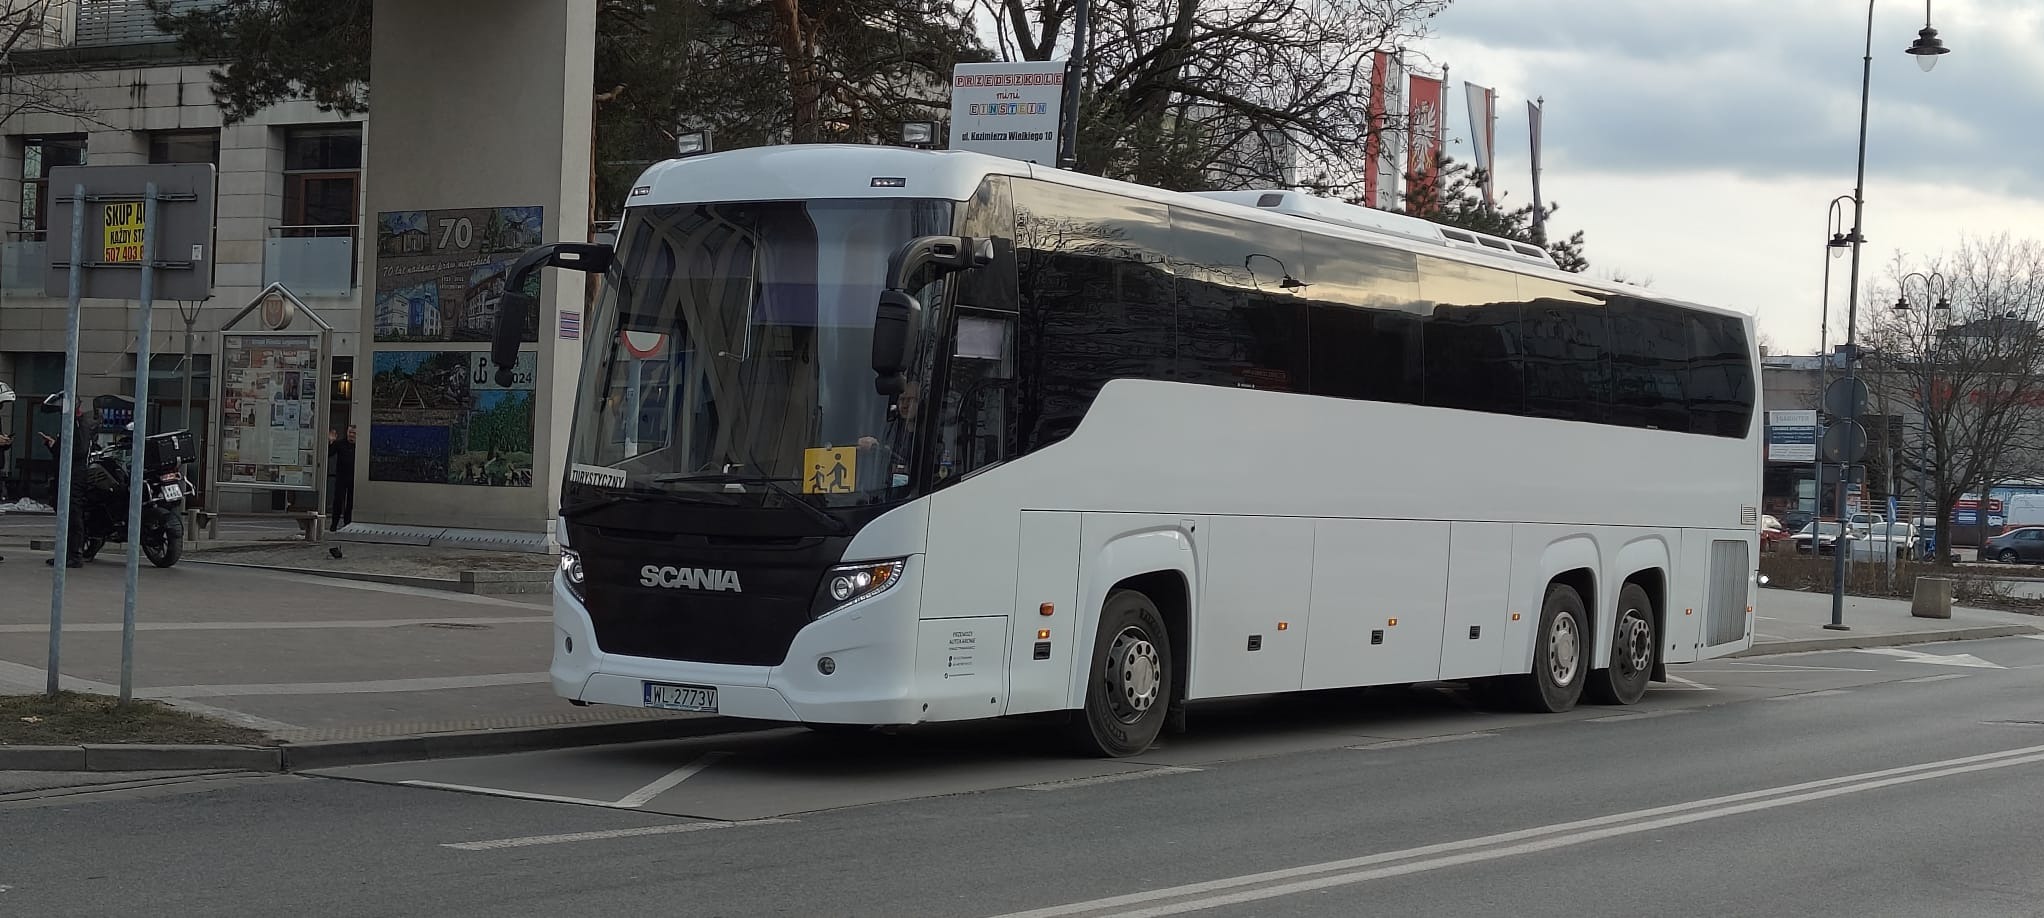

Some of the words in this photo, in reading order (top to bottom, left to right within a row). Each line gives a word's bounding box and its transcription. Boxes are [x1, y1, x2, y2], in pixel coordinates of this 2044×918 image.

[955, 73, 1063, 87] PRZEDSZKOLE
[996, 89, 1020, 99] mini
[969, 103, 1046, 115] EINSTEIN
[971, 132, 1007, 140] Kazimierza
[1008, 132, 1043, 141] Wielkiego
[1045, 131, 1053, 140] 10
[106, 205, 132, 226] SKUP
[438, 218, 473, 249] 70
[106, 247, 120, 261] 507
[122, 246, 137, 260] 403
[383, 265, 393, 277] 70
[513, 373, 532, 384] 024
[640, 565, 742, 593] SCANIA
[653, 686, 669, 703] WL
[674, 688, 715, 707] 2773V
